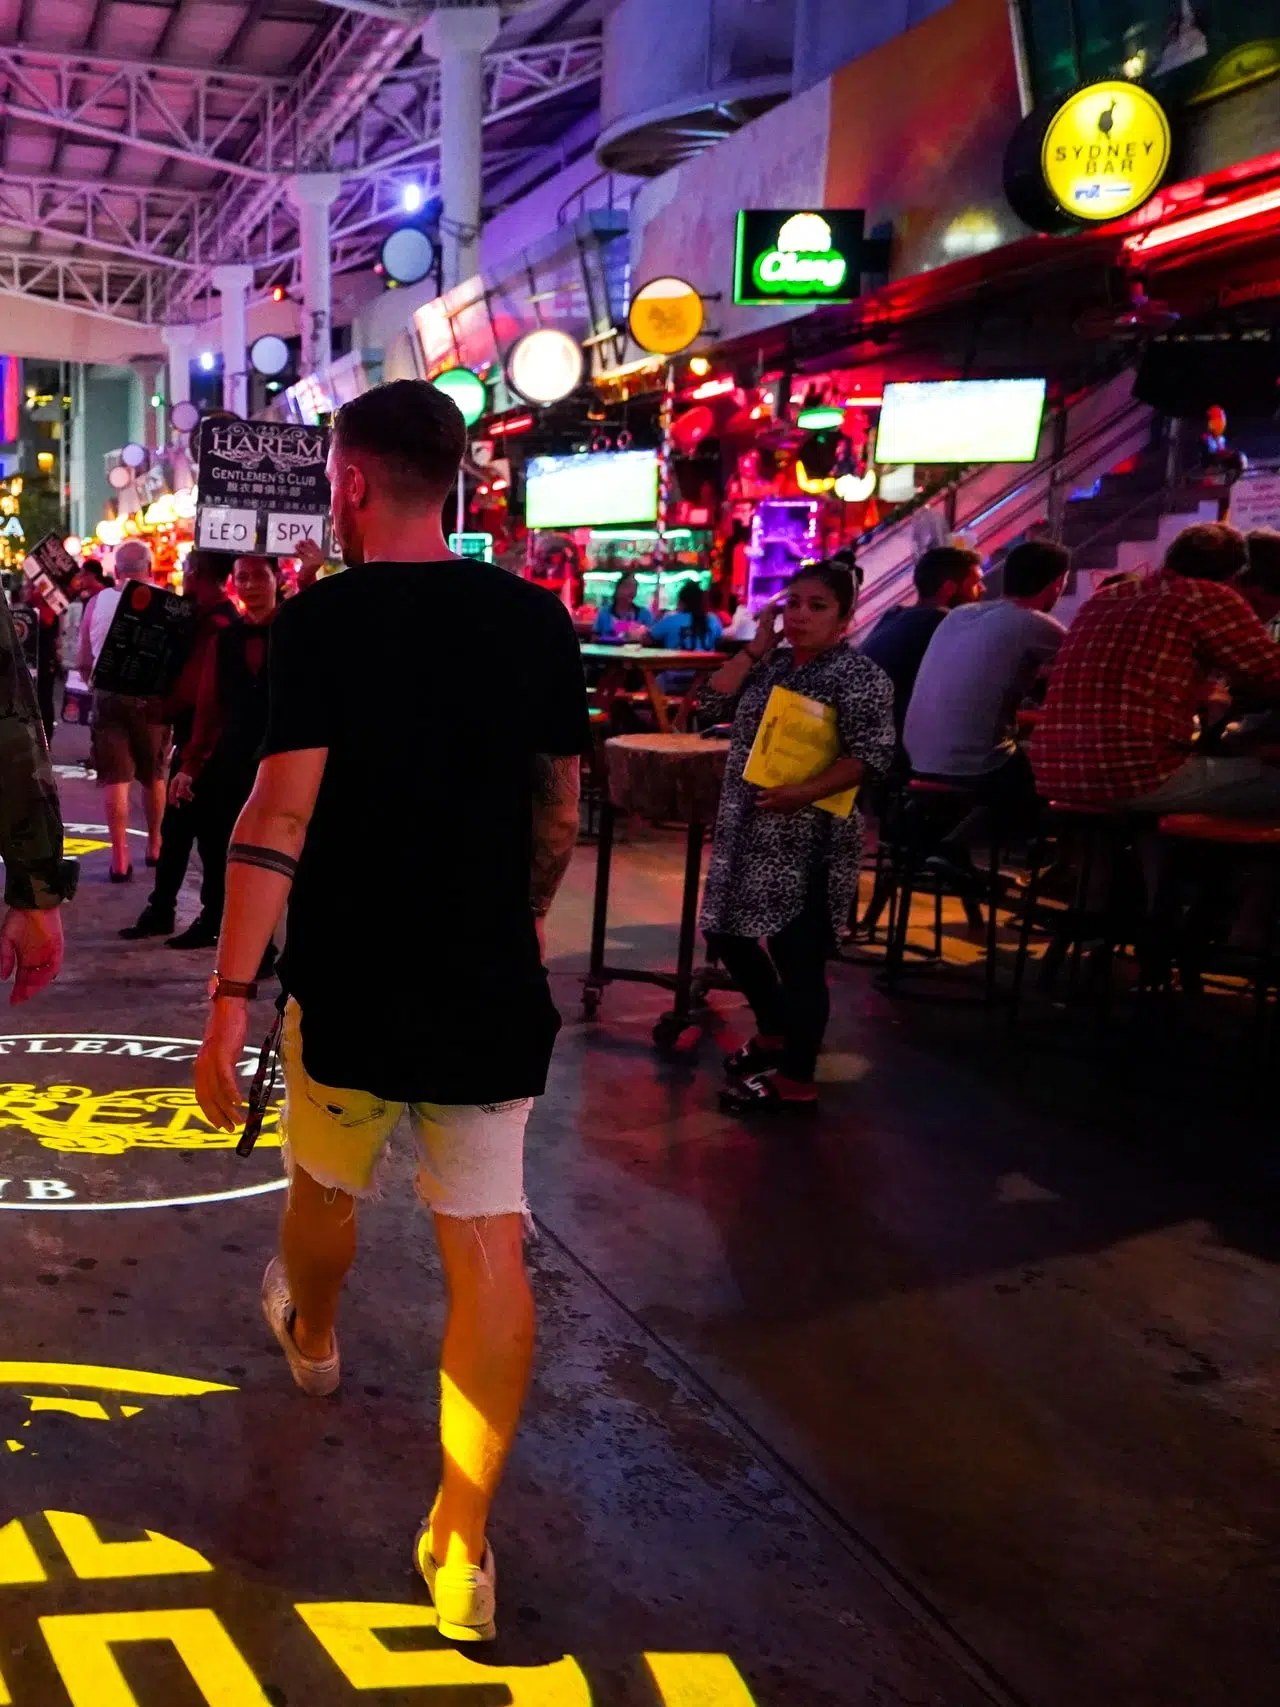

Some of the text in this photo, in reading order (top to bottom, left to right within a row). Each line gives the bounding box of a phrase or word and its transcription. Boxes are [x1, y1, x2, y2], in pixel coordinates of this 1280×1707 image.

[1055, 140, 1154, 162] SYDNEY
[1085, 158, 1134, 177] BAR
[760, 251, 846, 287] Chang
[213, 432, 322, 455] HAREM
[212, 467, 316, 486] GENTLEMEN'S CLUB
[209, 523, 313, 541] LEO SPY
